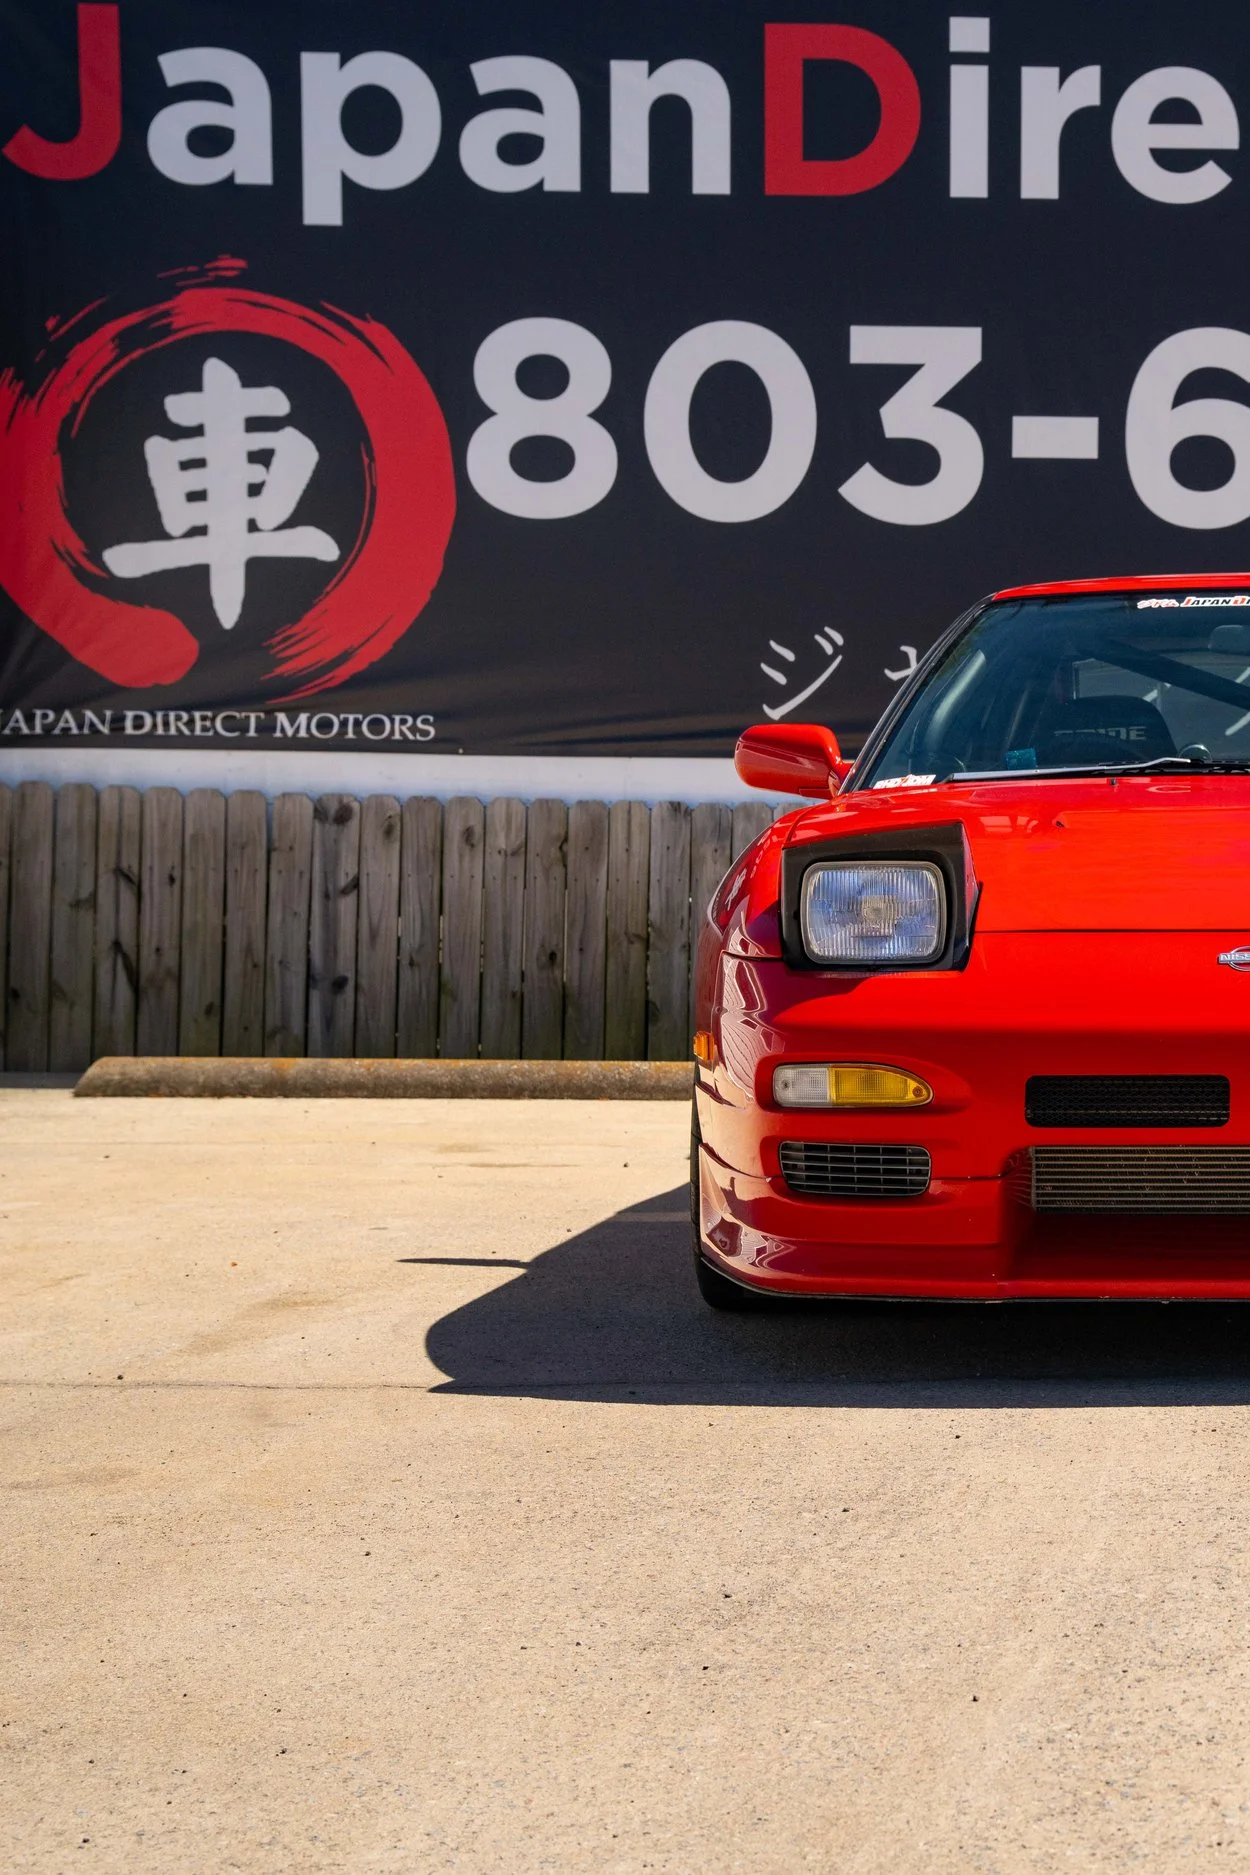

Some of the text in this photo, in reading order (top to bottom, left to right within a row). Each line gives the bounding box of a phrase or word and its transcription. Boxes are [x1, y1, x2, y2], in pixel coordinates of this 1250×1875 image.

[102, 357, 341, 630] 車
[0, 708, 436, 741] APAN DIRECT MOTORS
